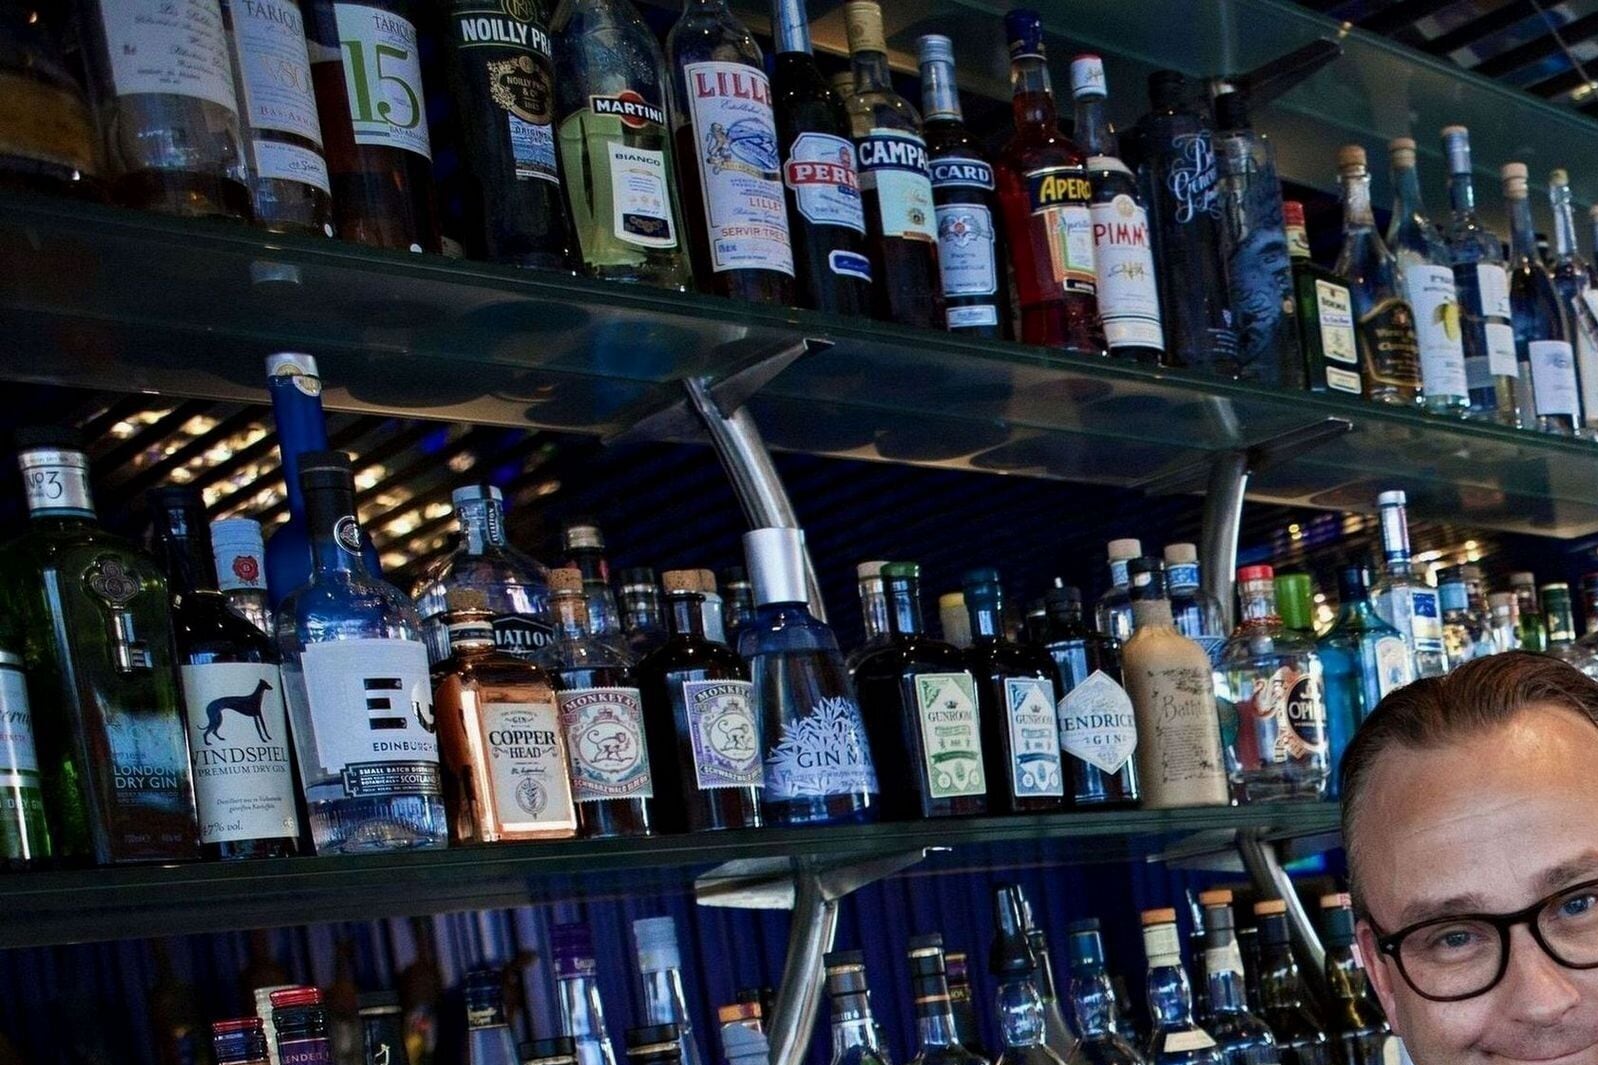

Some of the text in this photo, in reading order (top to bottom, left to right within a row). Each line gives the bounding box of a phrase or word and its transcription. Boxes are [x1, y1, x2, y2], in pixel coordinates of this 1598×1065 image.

[461, 19, 527, 45] NOILLY
[340, 41, 420, 129] 15
[596, 99, 663, 124] MARTINI
[615, 153, 661, 167] BIANCO
[46, 470, 63, 499] 3
[565, 693, 626, 713] MONKEY
[489, 730, 557, 747] COPPER
[1093, 735, 1123, 746] GIN
[510, 747, 542, 759] HEAD
[797, 750, 841, 769] GIN
[113, 765, 177, 777] LONDON
[199, 764, 287, 778] PREMIUM DRY GIN
[114, 776, 178, 790] DRY GIN
[285, 1051, 324, 1065] ENDED
